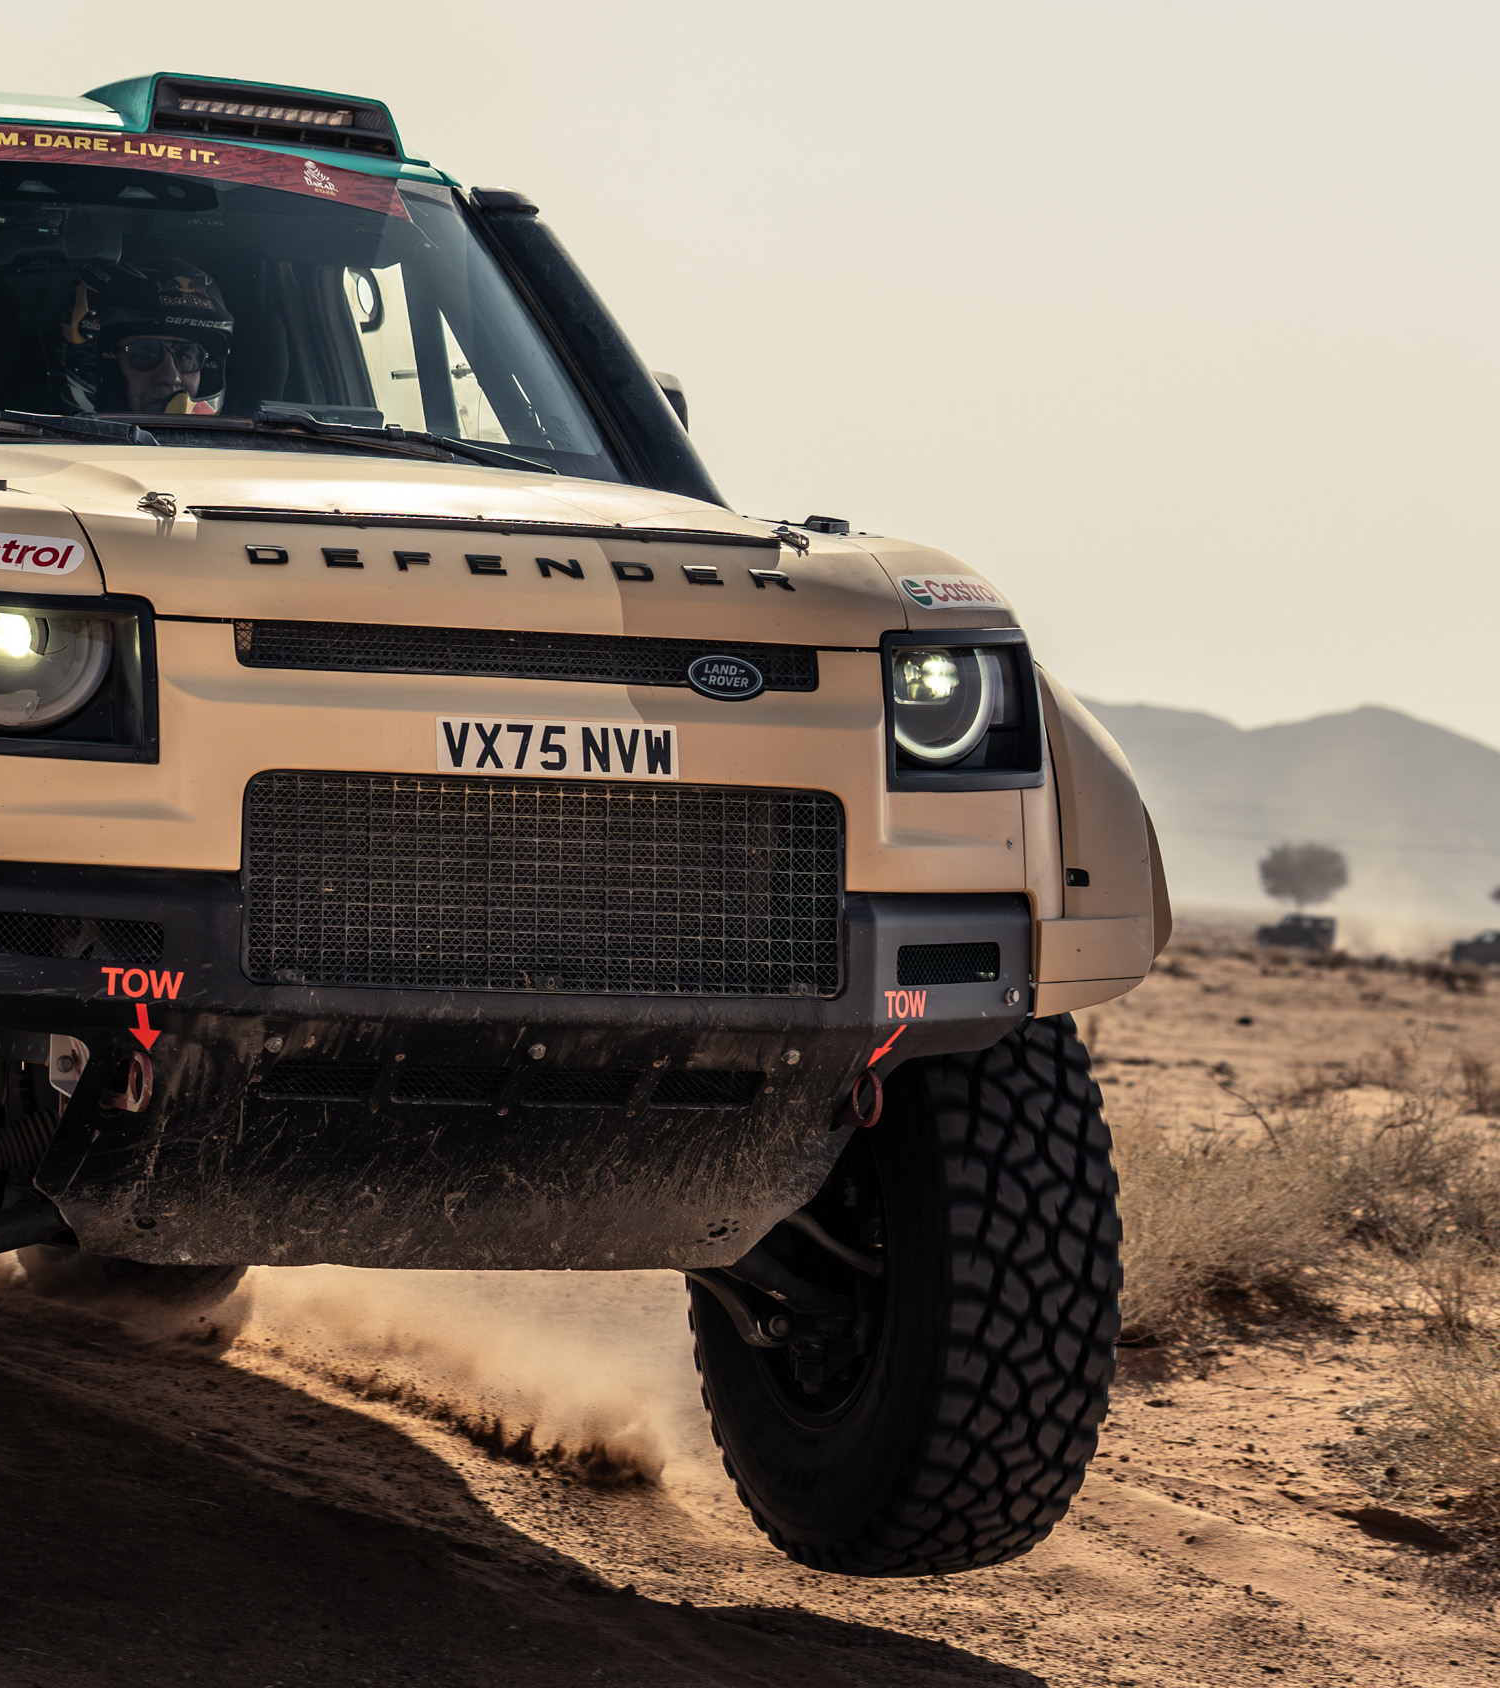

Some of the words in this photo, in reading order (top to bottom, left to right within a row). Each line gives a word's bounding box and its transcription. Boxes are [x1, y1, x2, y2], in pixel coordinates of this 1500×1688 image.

[34, 133, 117, 152] DARE.
[124, 141, 183, 160] LIVE
[190, 149, 220, 165] IT.
[303, 176, 339, 192] DAKAR
[159, 294, 188, 305] Red
[244, 544, 796, 592] DEFENDER
[924, 579, 1002, 604] Castrol
[704, 663, 738, 676] LAND
[707, 675, 749, 688] ROVER
[442, 721, 567, 771] VX75
[581, 726, 671, 775] NVW
[101, 966, 185, 1000] TOW
[884, 990, 927, 1019] TOW
